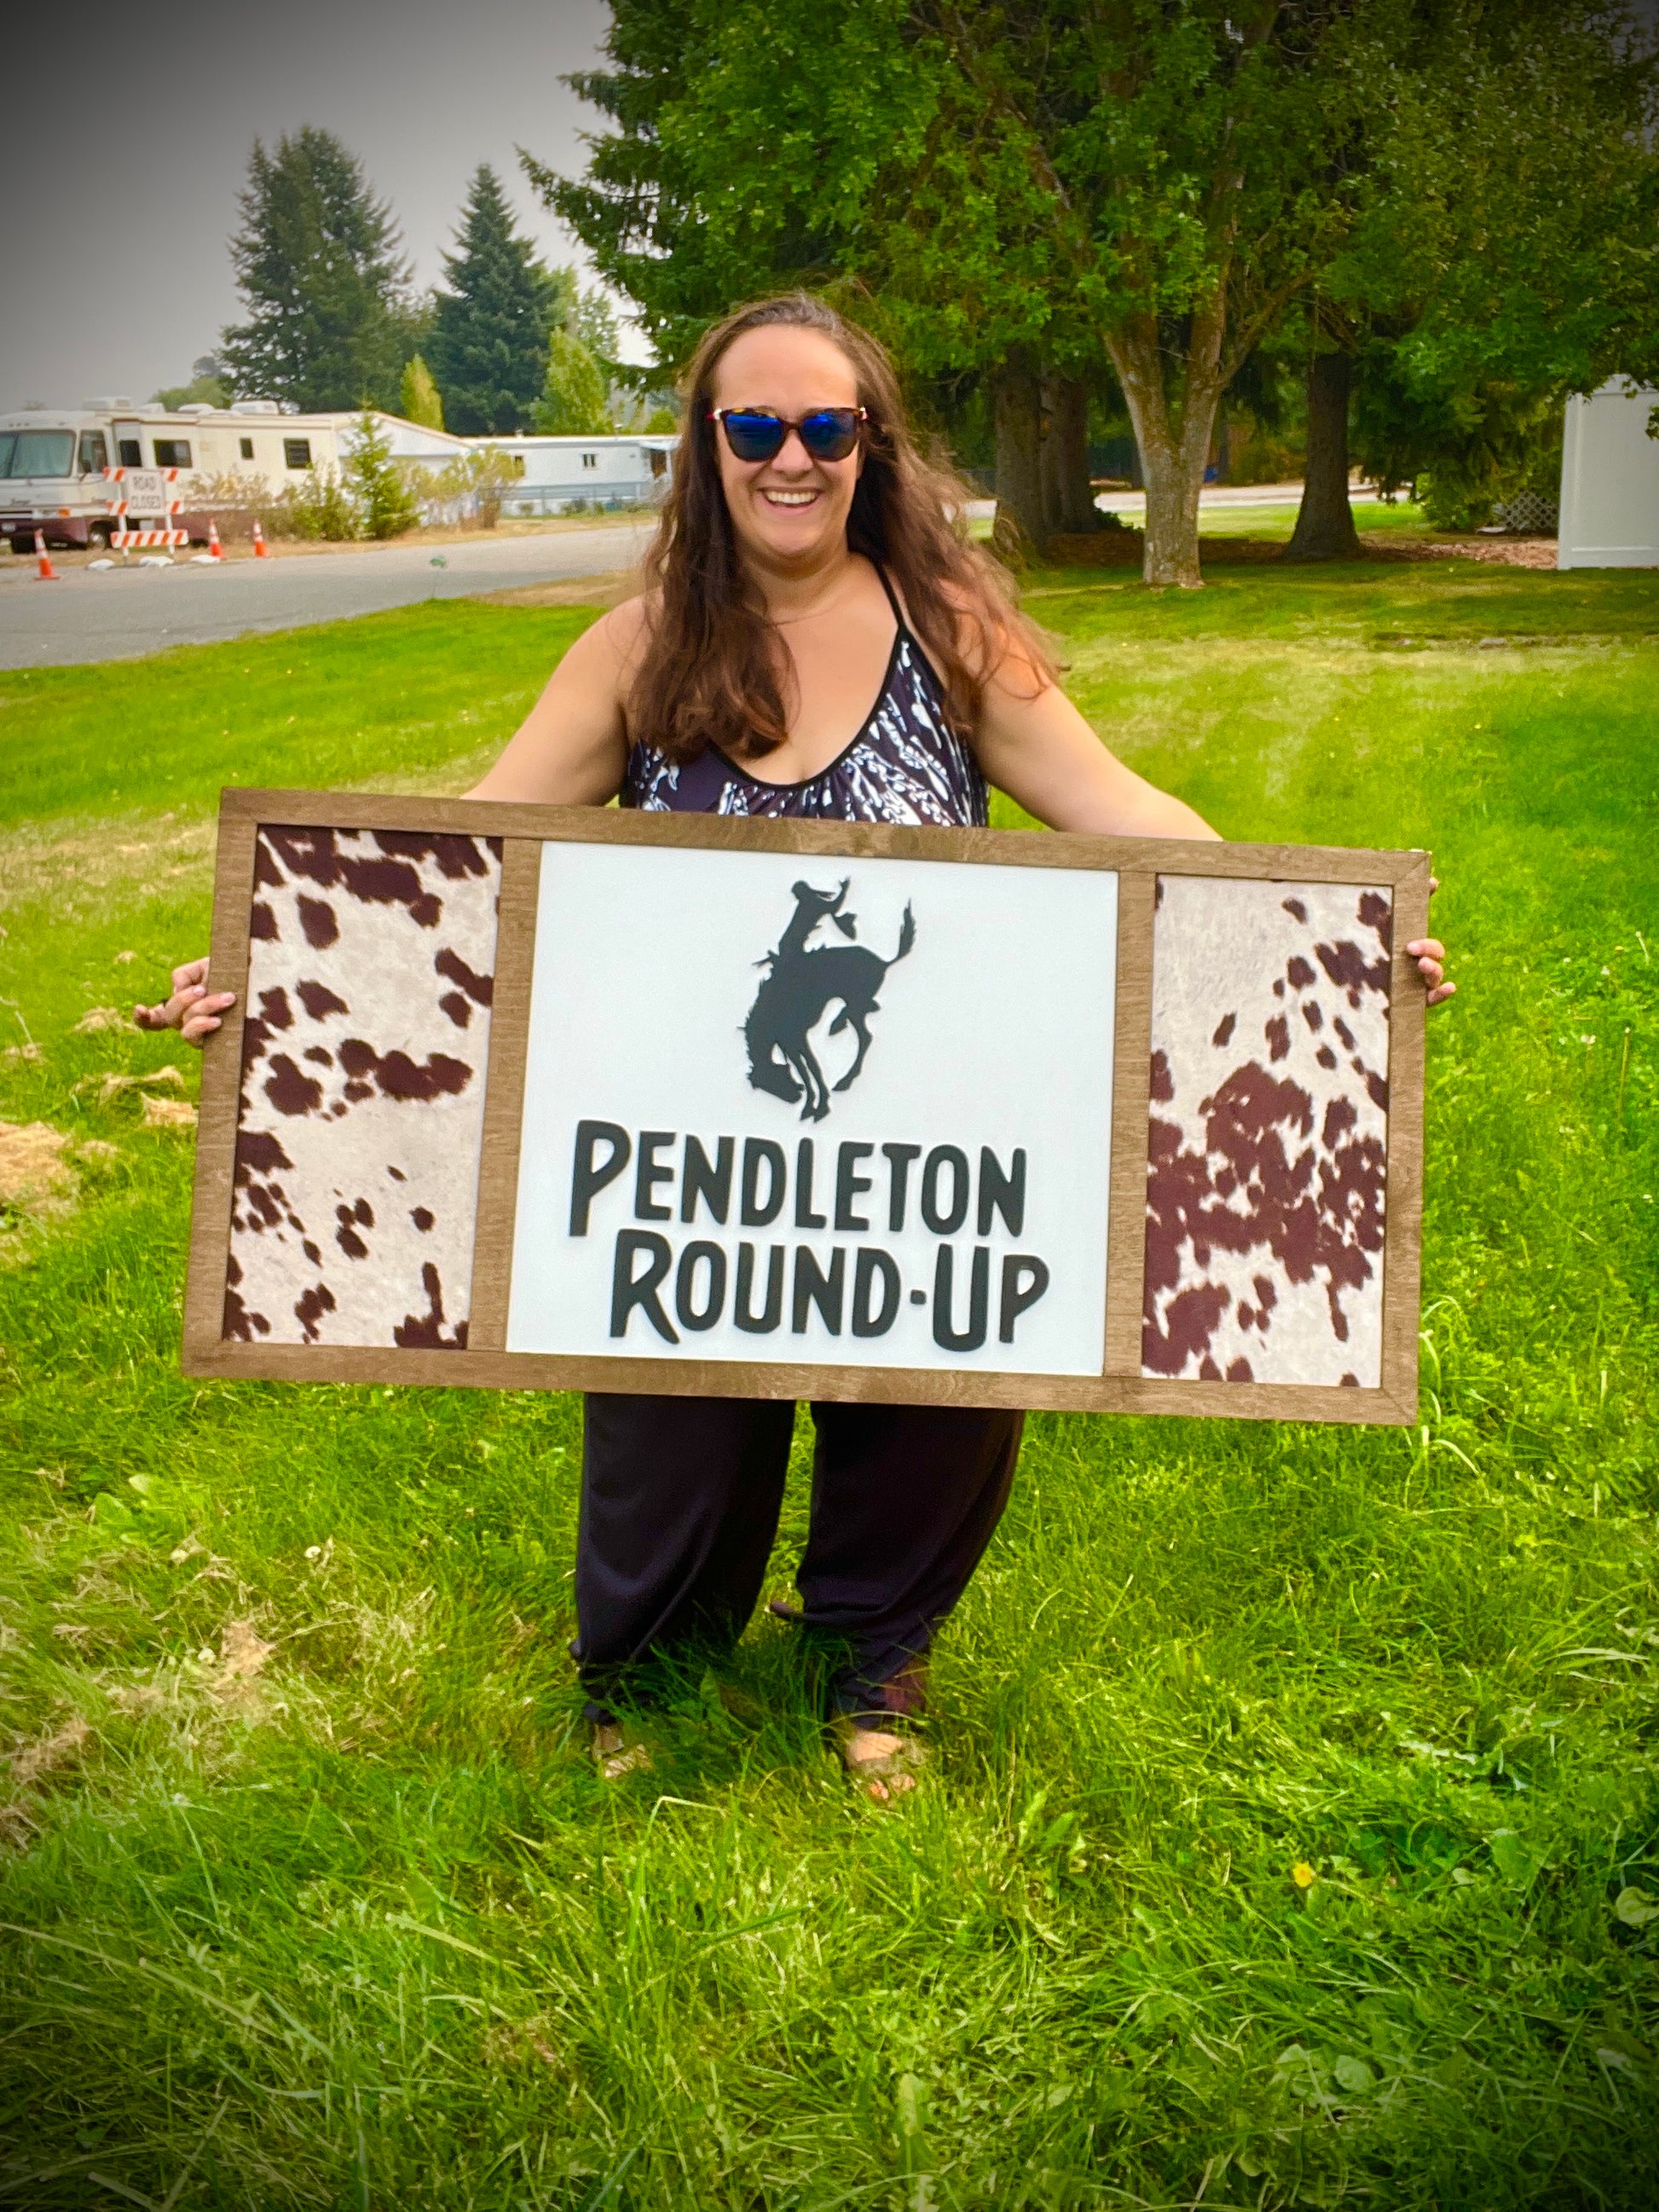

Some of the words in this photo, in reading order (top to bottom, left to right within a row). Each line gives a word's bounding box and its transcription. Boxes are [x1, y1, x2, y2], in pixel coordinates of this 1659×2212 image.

[130, 495, 161, 510] CLOSED
[132, 476, 157, 490] ROAD
[569, 1120, 1026, 1237] PENDLETON
[610, 1229, 1049, 1352] ROUND-UP
